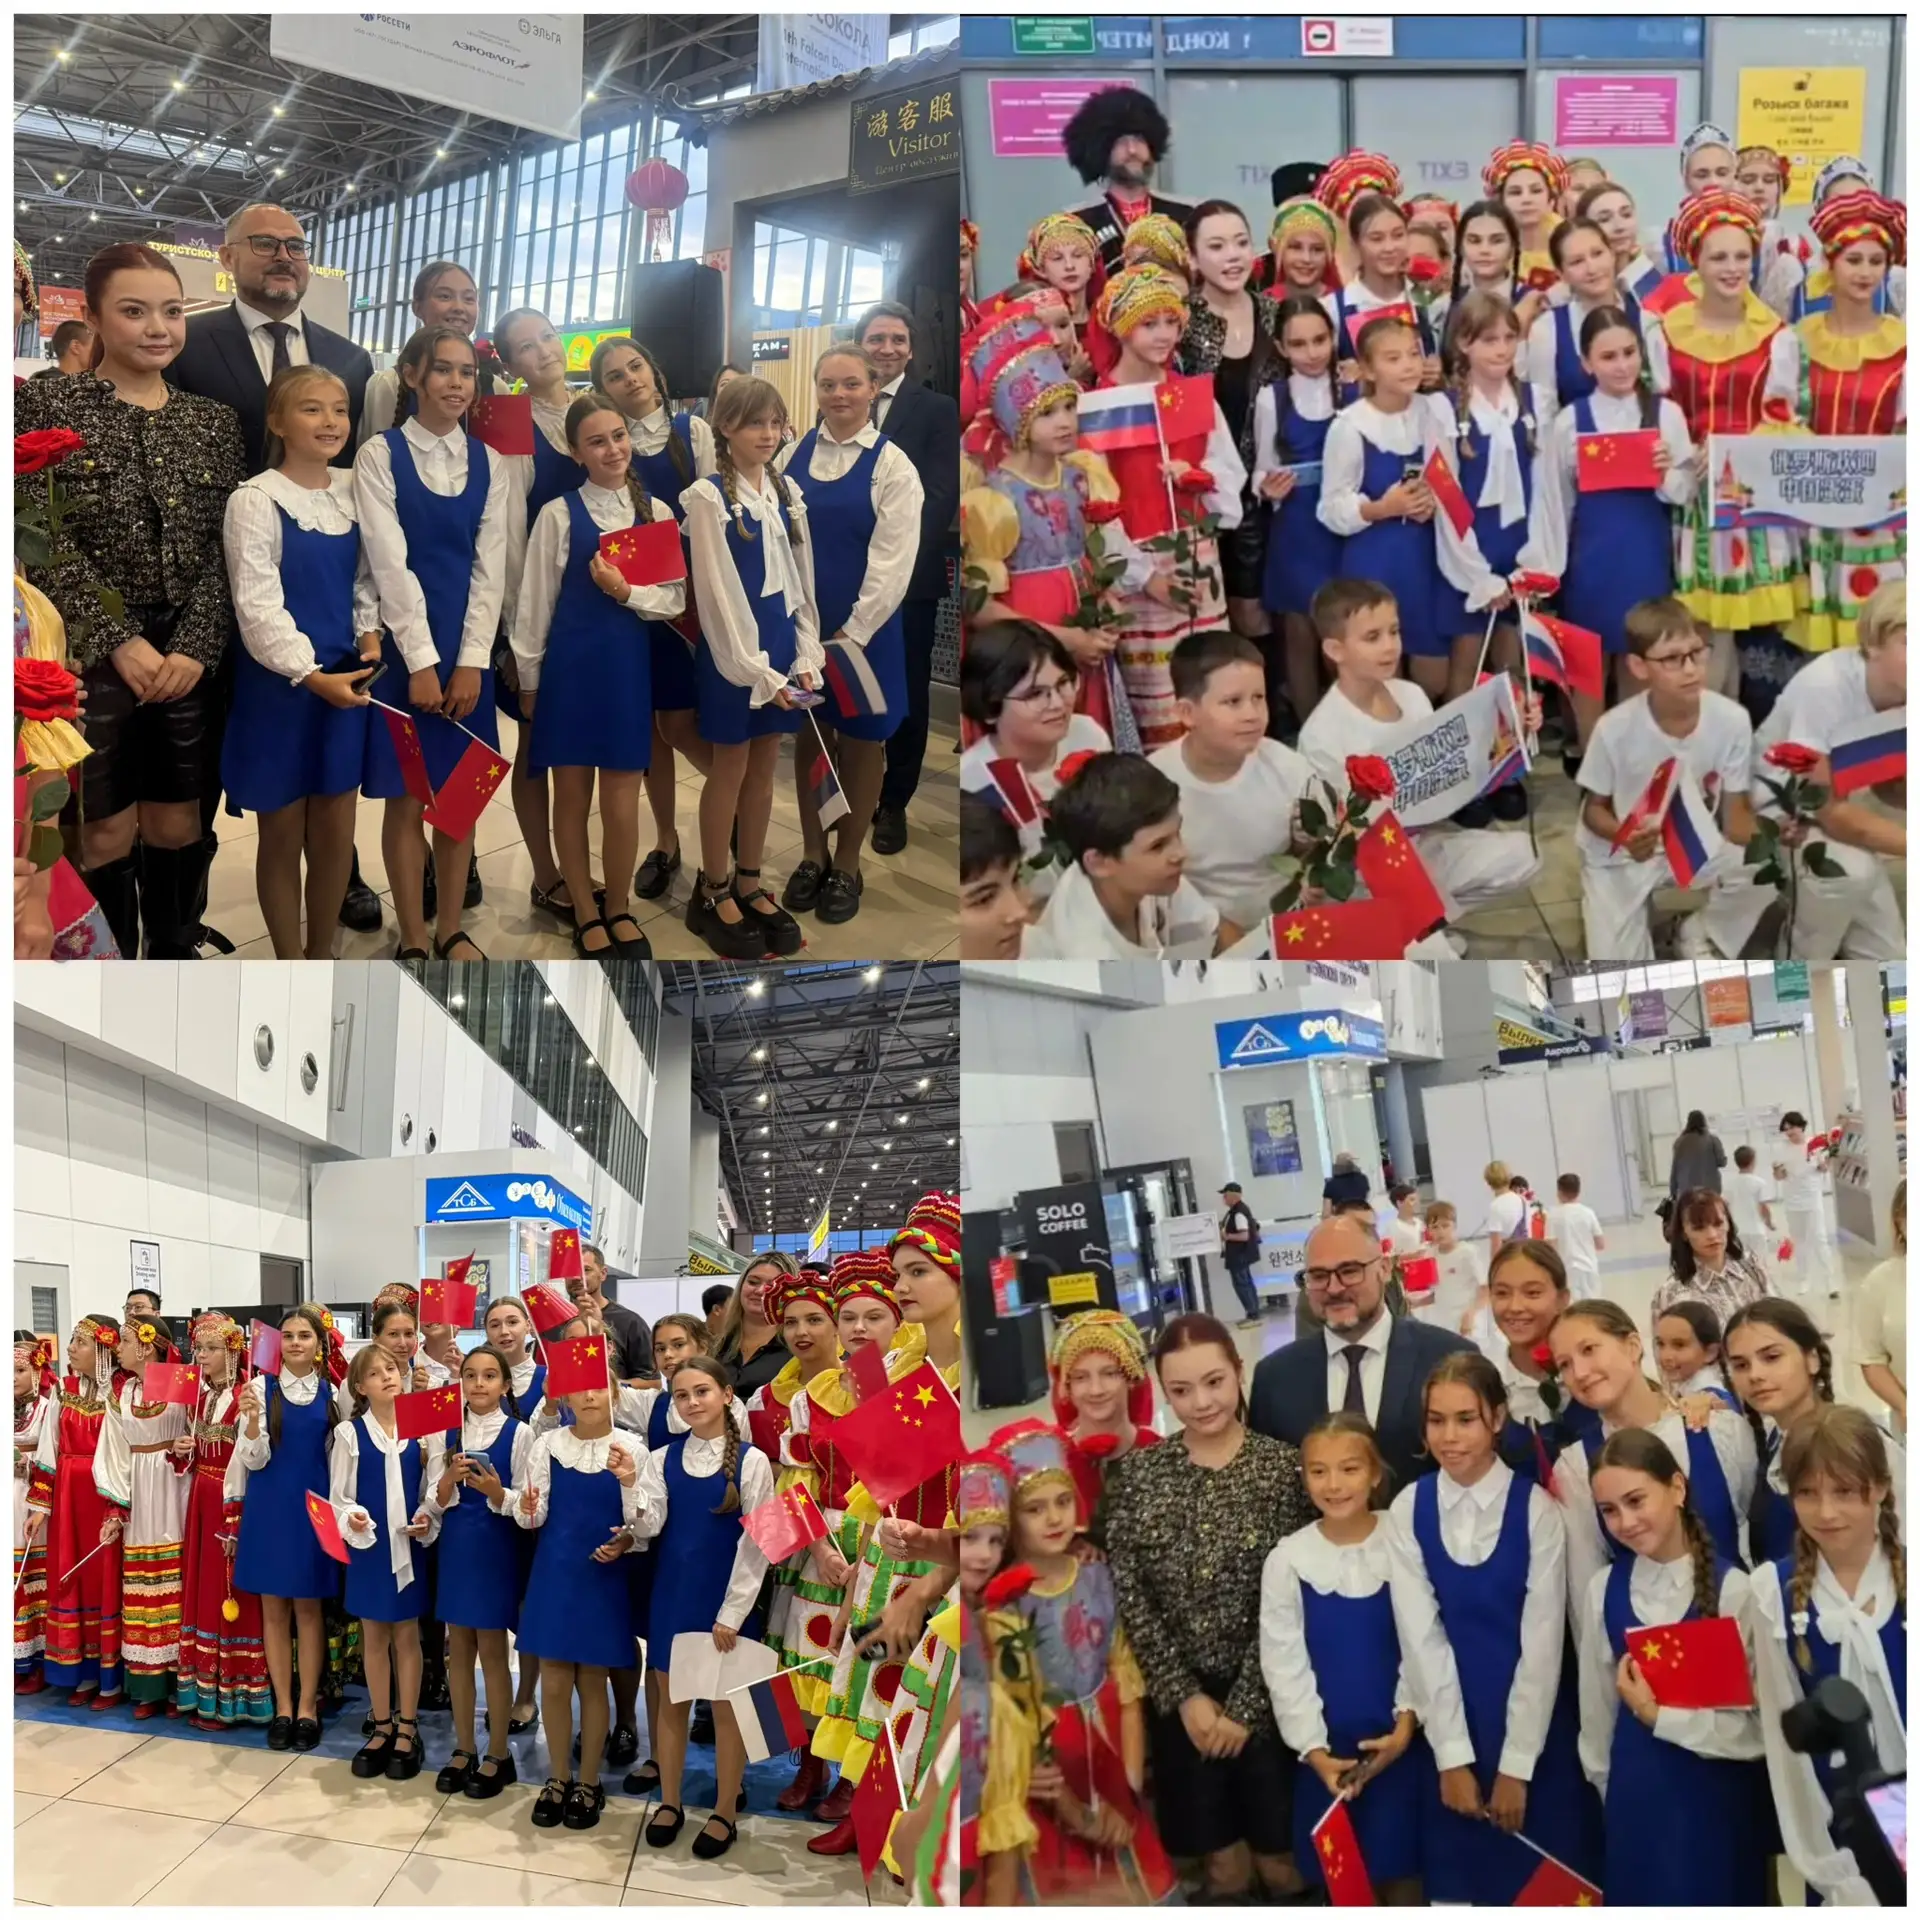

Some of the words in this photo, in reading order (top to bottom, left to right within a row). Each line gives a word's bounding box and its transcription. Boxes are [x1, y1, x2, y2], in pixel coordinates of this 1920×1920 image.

[376, 14, 411, 31] РОССЕТИ
[532, 24, 562, 45] ЭЛЬГА
[452, 40, 516, 67] АЭРОФЛОТ
[1753, 98, 1800, 109] Розыск
[1805, 98, 1848, 109] багажа
[867, 92, 953, 137] 游客服
[889, 131, 951, 157] Visitor
[316, 266, 346, 279] ЦЕНТР
[1035, 1202, 1085, 1222] SOLO
[1038, 1218, 1089, 1235] COFFEE
